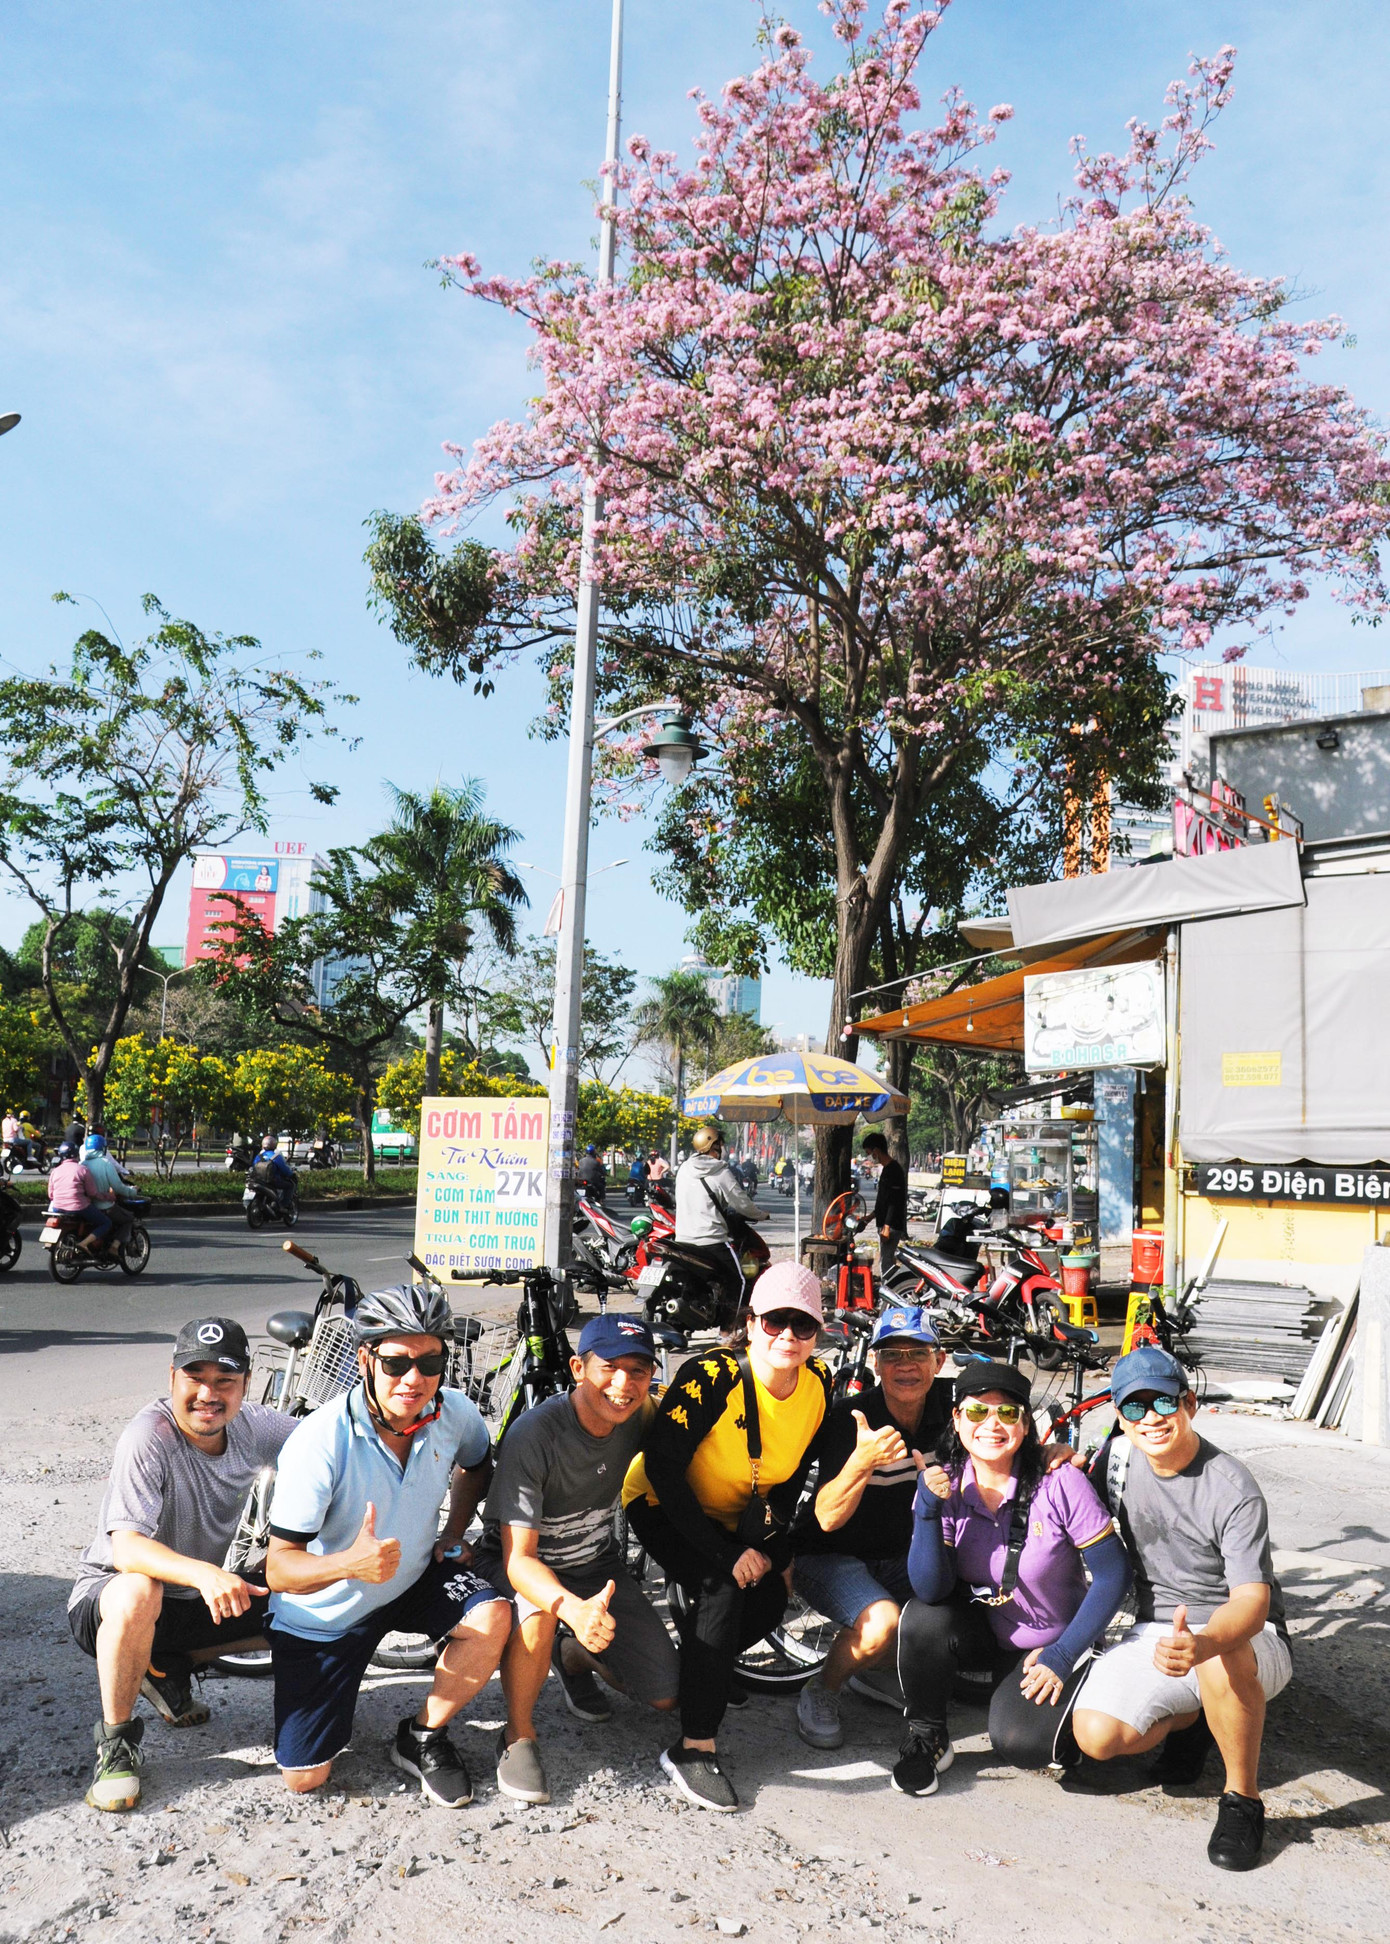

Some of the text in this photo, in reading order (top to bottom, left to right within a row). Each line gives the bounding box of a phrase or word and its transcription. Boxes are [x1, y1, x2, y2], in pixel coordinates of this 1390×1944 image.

[274, 841, 307, 855] UEF
[746, 1066, 795, 1087] be
[808, 1063, 860, 1086] be
[427, 1102, 543, 1140] CƠM TẤM
[441, 1146, 470, 1165] Tư
[434, 1184, 495, 1204] CƠM TẤM
[496, 1170, 543, 1197] 27K
[1206, 1168, 1255, 1192] 295
[1261, 1170, 1325, 1200] Điện
[433, 1206, 539, 1228] BÚN THỊT NƯỚNG
[469, 1233, 499, 1249] CƠM
[504, 1235, 536, 1251] TRƯA
